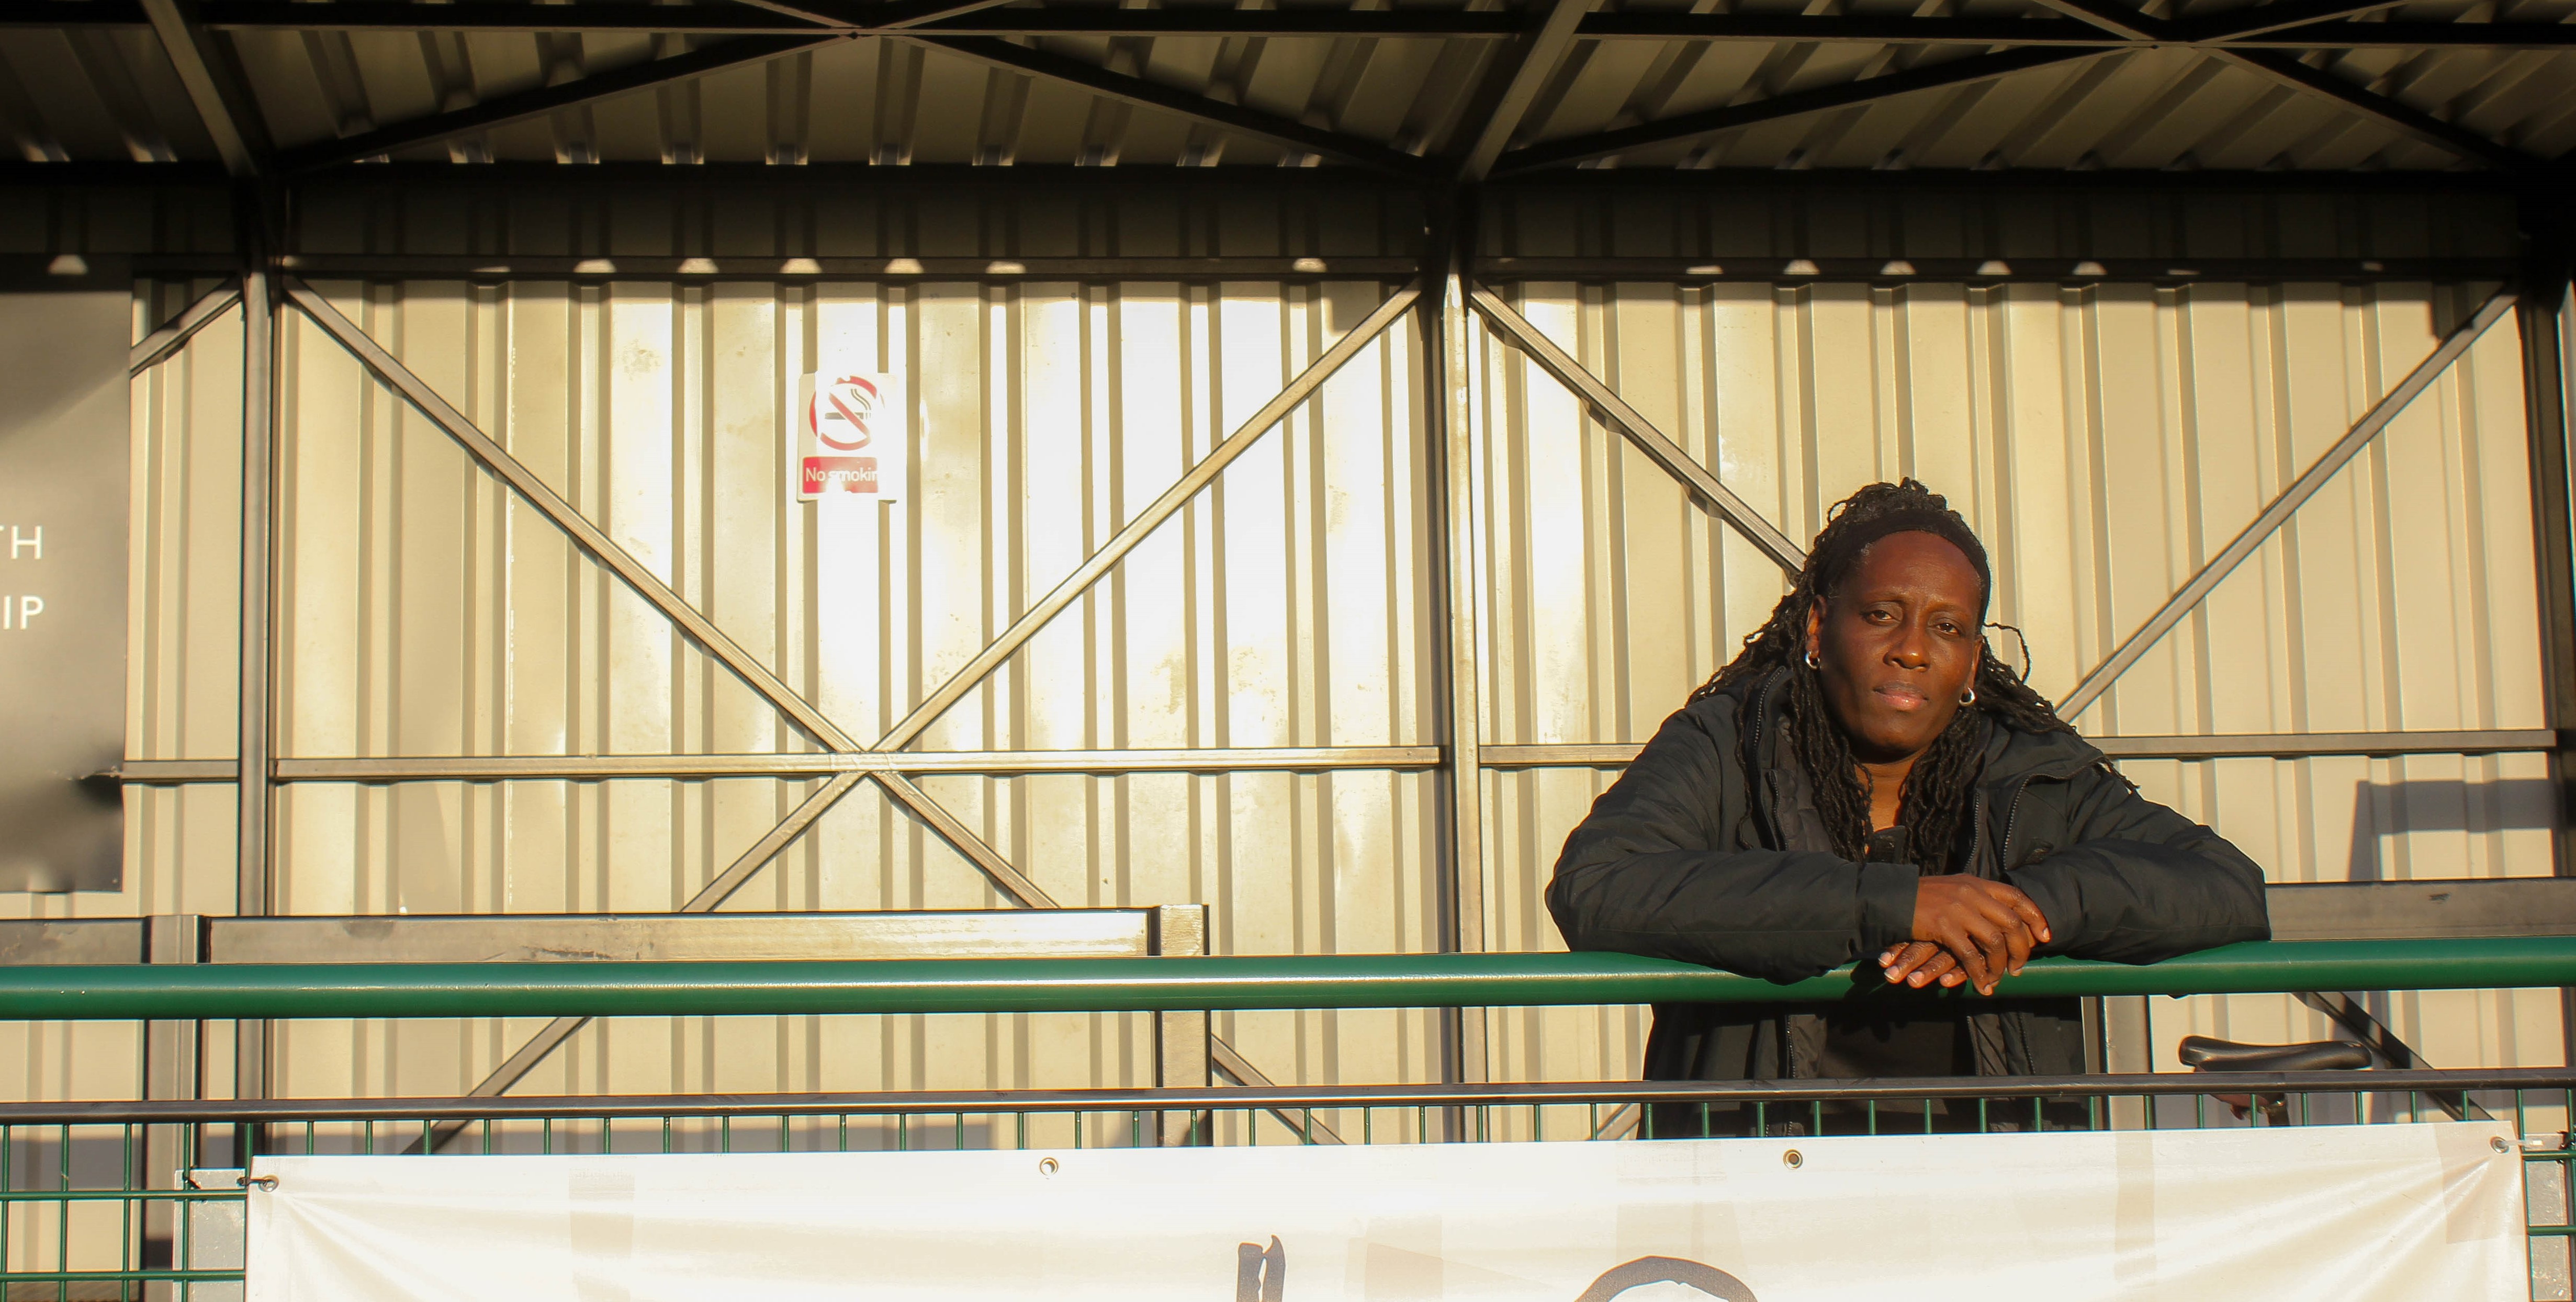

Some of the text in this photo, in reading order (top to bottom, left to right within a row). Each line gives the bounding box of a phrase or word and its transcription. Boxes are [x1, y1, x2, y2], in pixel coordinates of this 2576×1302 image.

[806, 467, 825, 482] No
[0, 525, 43, 559] H
[3, 595, 44, 630] IP
